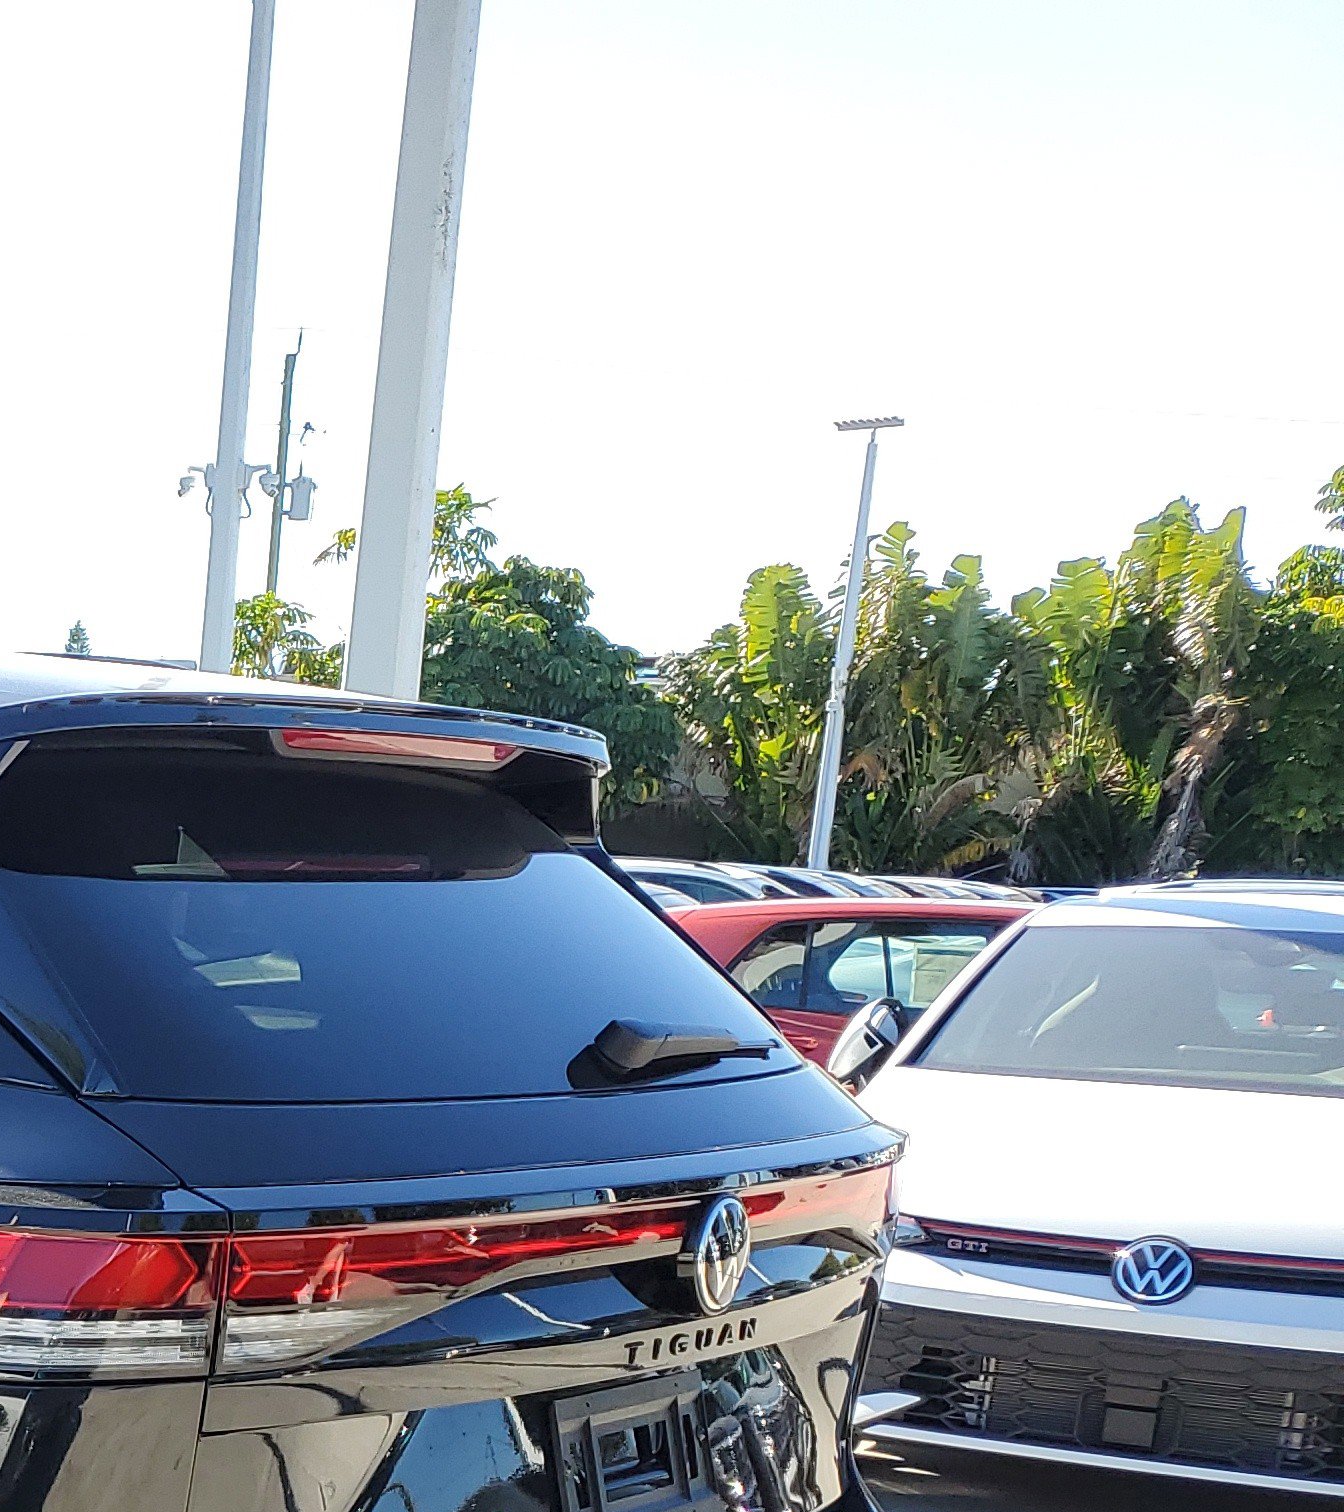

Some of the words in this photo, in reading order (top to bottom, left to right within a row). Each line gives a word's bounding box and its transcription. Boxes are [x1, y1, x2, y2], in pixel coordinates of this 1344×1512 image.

[947, 1239, 988, 1253] GTI
[1115, 1239, 1193, 1301] VW
[624, 1318, 757, 1363] TIGUAN
